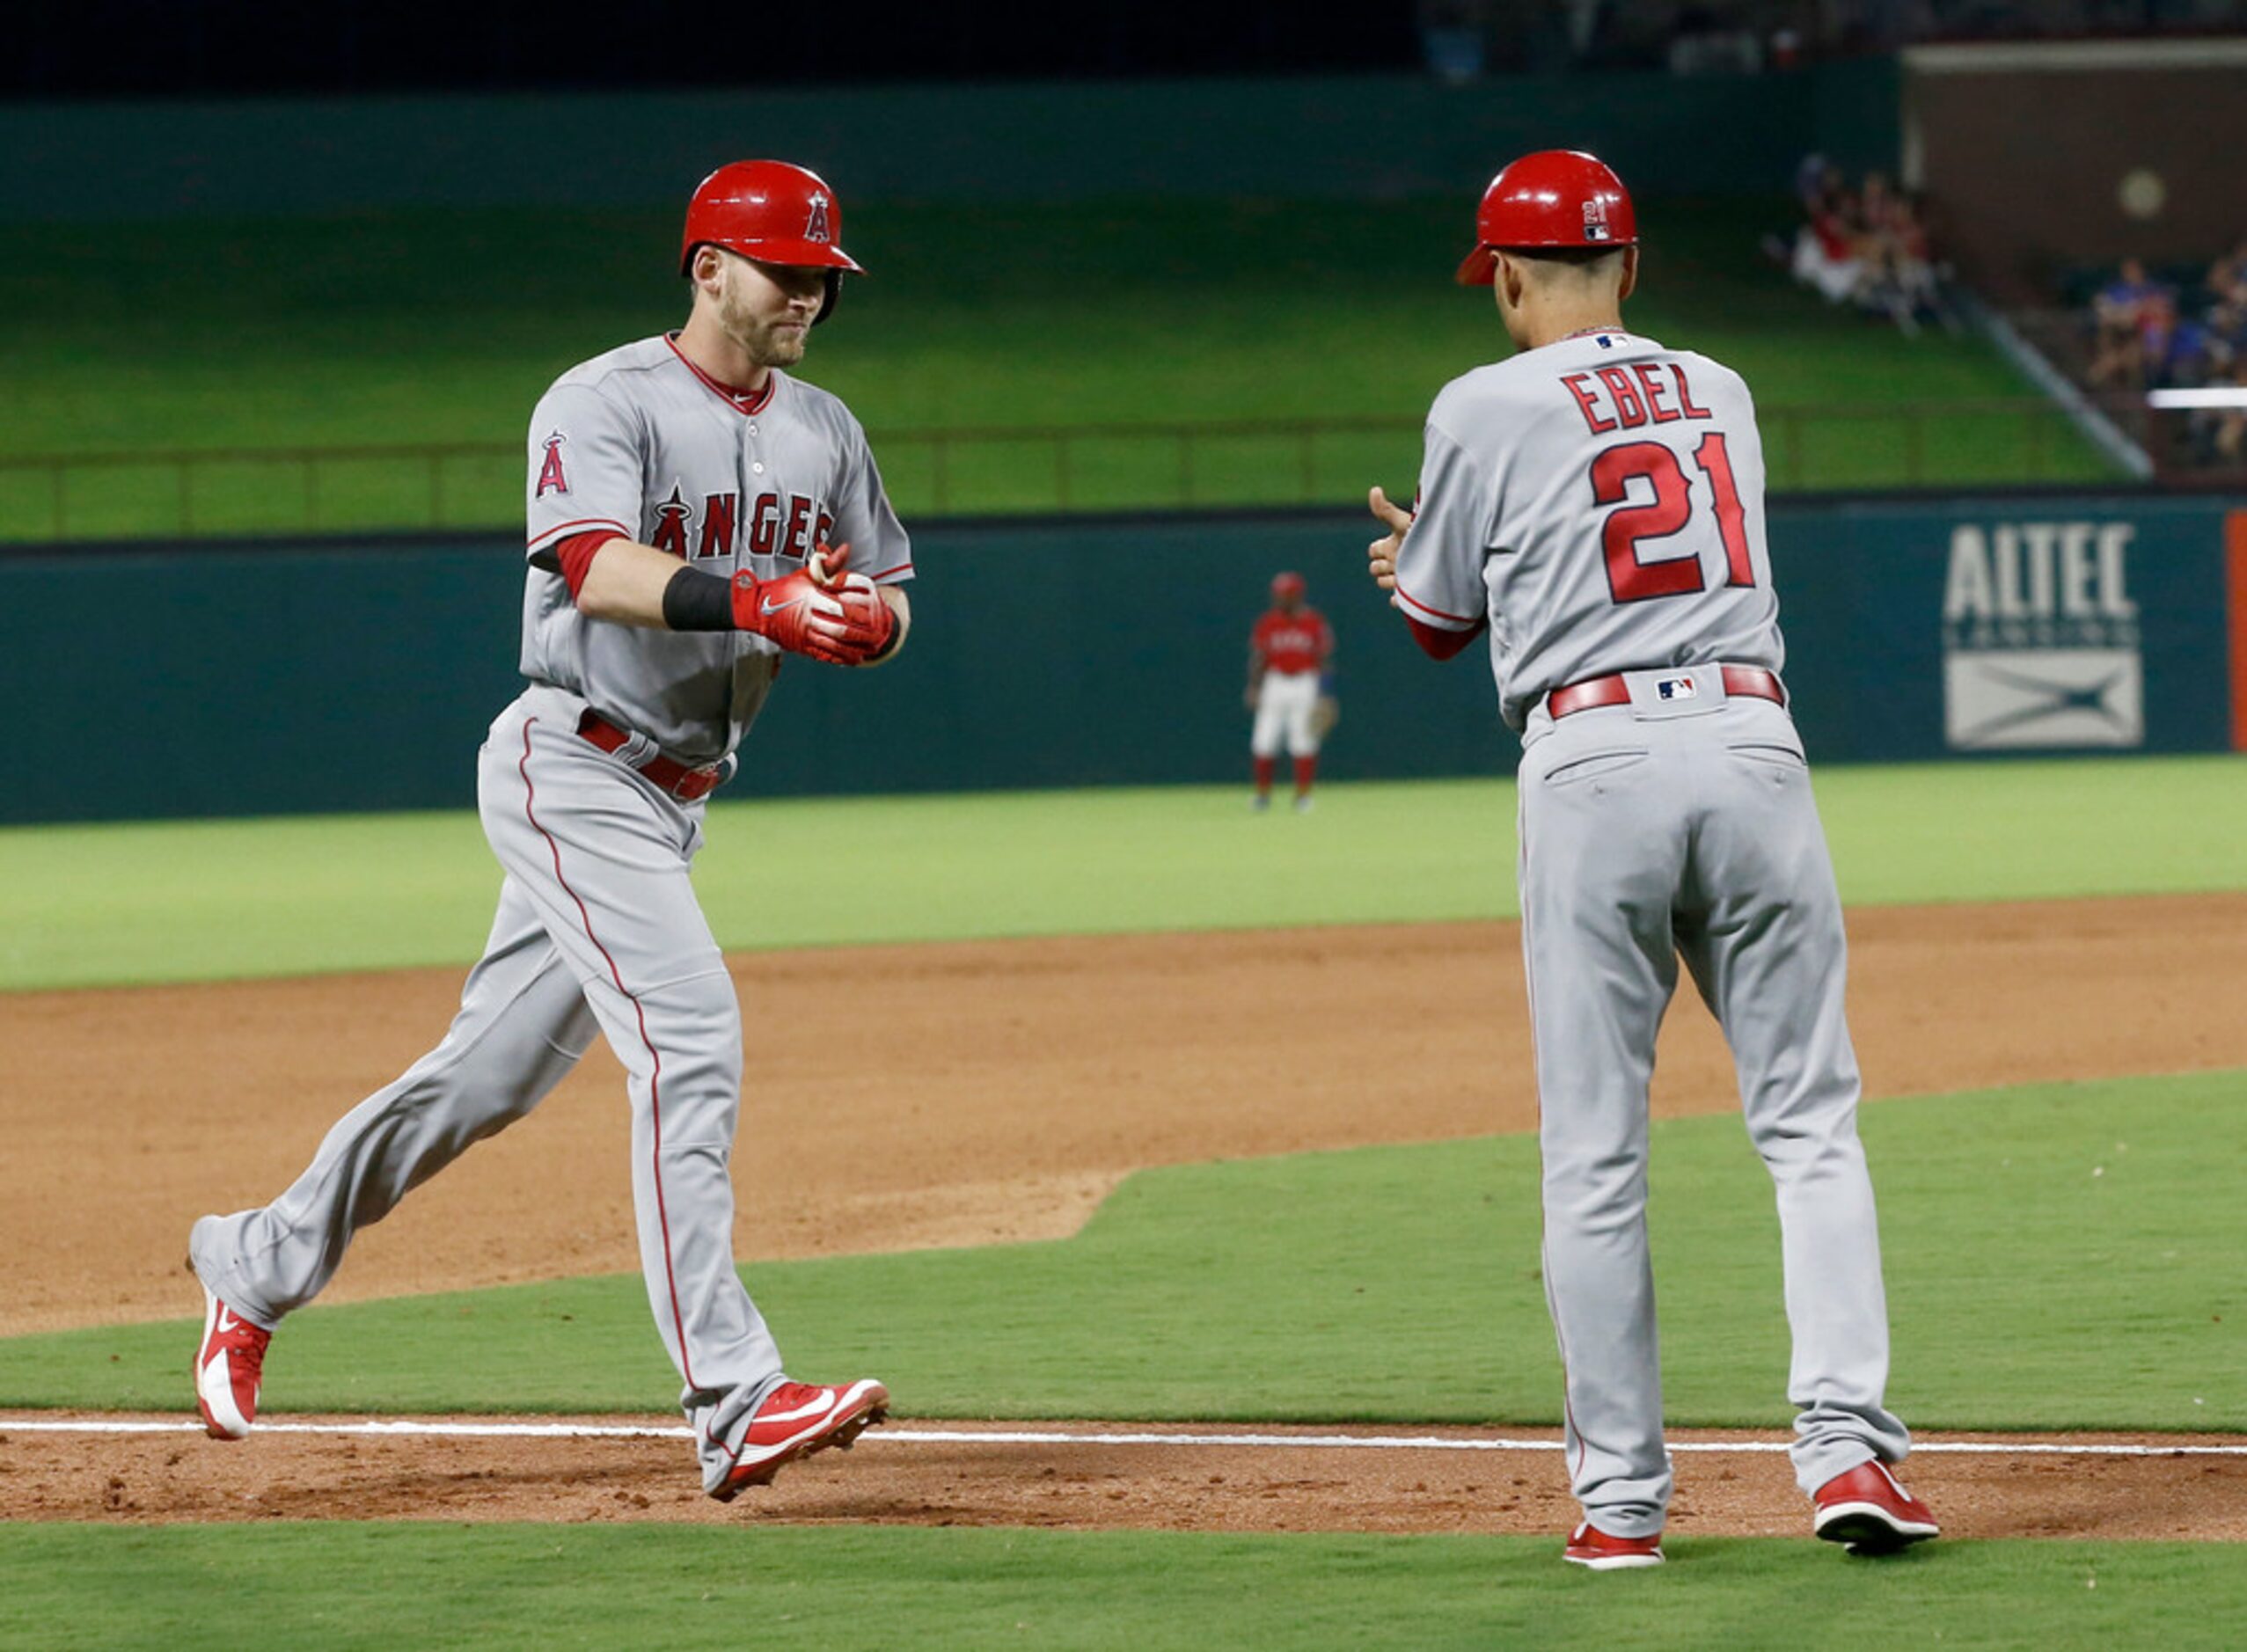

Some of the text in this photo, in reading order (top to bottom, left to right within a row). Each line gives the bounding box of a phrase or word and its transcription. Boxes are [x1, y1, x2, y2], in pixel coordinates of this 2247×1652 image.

[804, 191, 830, 243] A
[1582, 194, 1607, 224] 21
[1560, 363, 1713, 435] EBEL
[535, 428, 568, 498] A
[1589, 431, 1756, 605] 21
[1944, 523, 2137, 618] ALTEC
